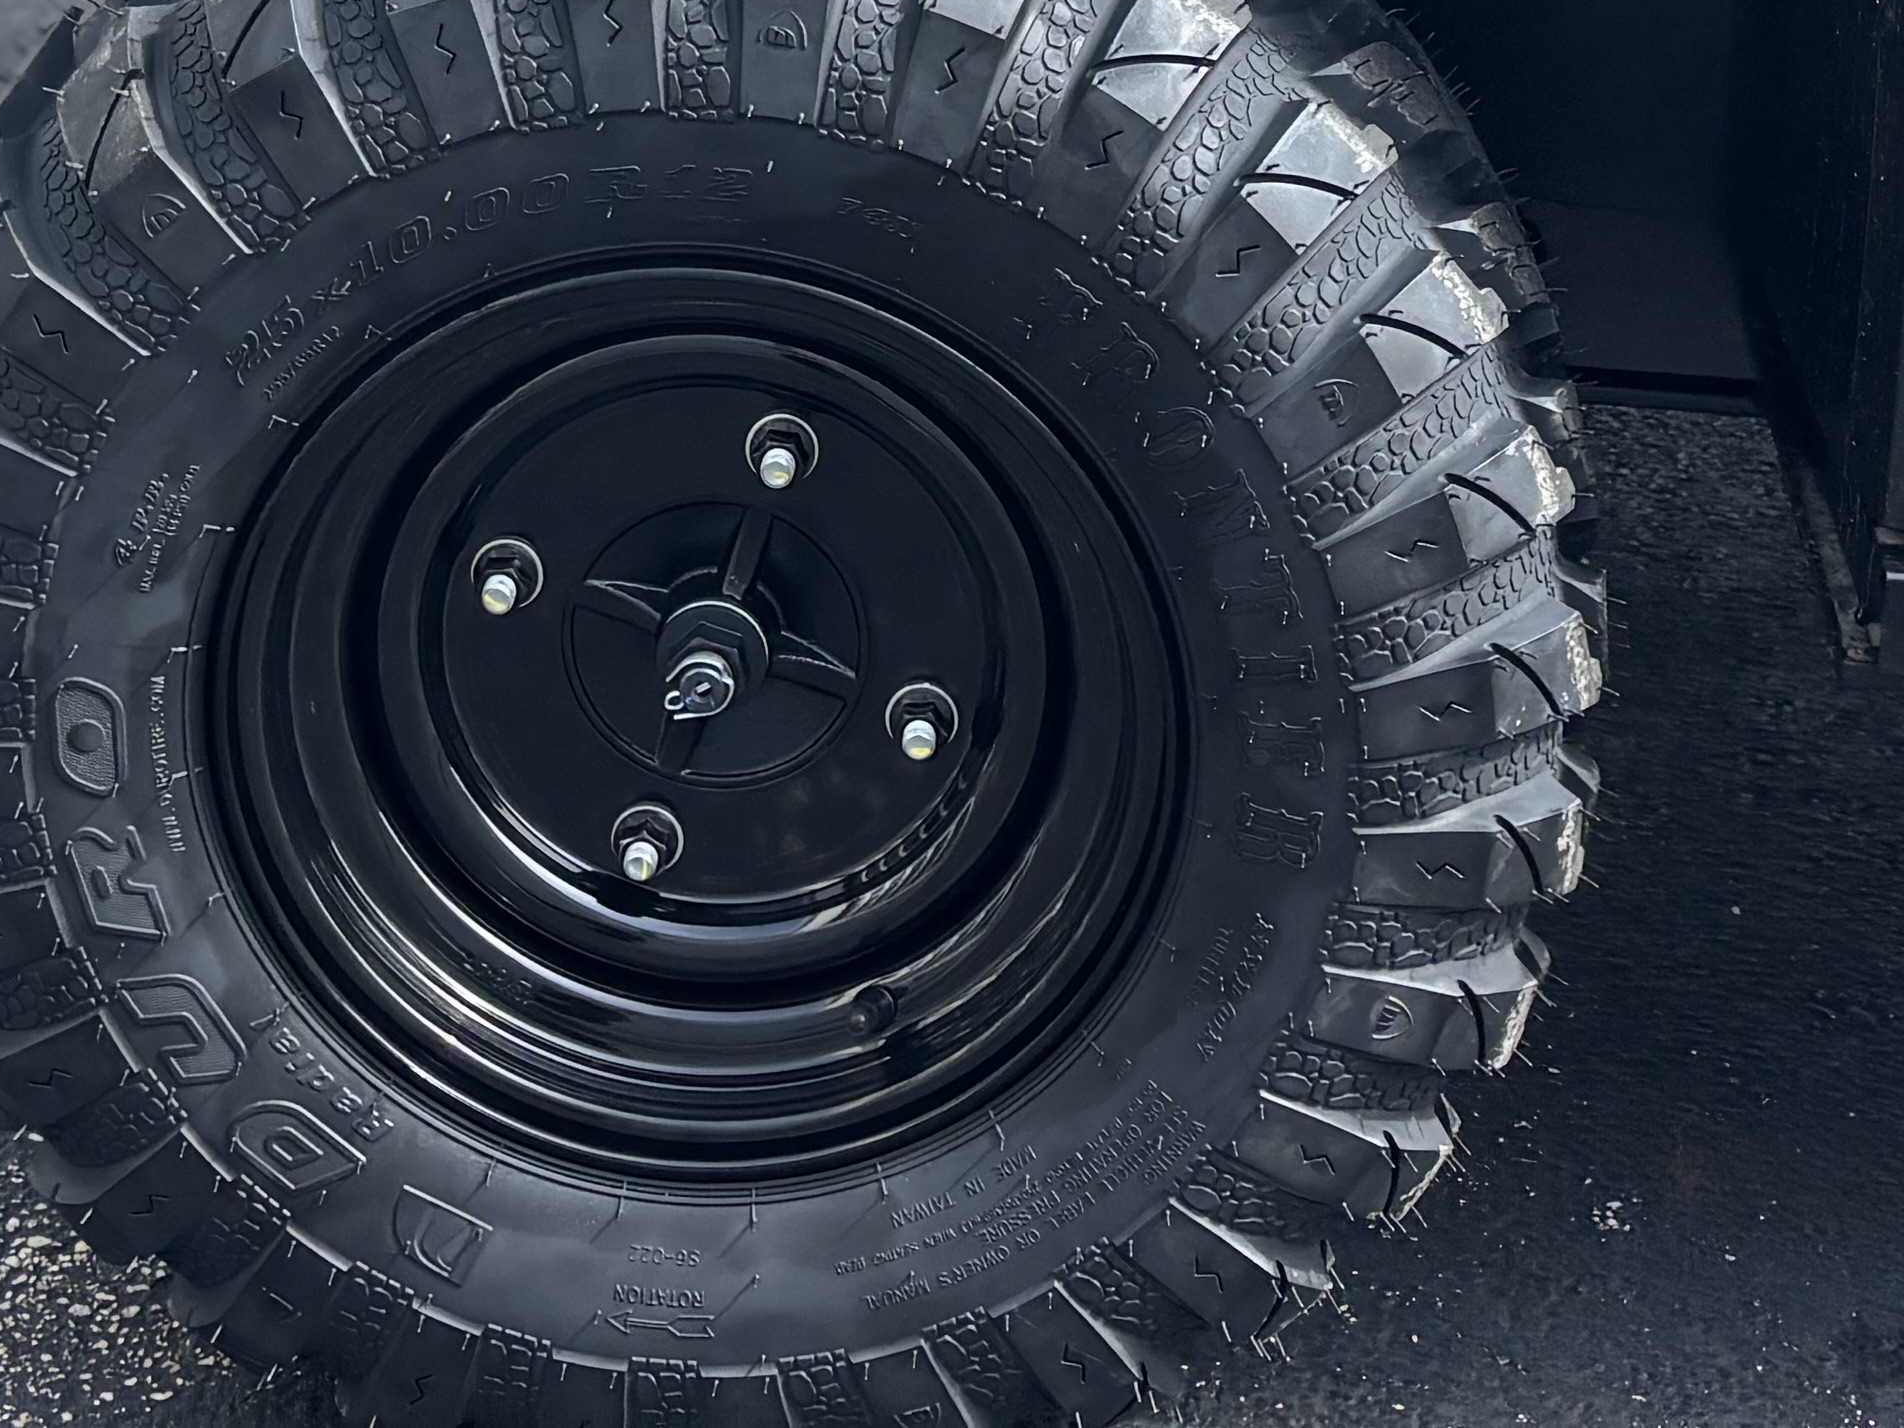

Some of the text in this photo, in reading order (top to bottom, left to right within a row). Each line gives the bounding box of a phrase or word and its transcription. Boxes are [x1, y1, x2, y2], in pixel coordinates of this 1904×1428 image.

[1012, 266, 1325, 870] FRONTIER
[54, 675, 368, 1191] DURO
[249, 1005, 395, 1142] Radial
[889, 1144, 1038, 1231] MADE IN TAIWAN
[611, 1281, 705, 1309] ROTATION
[863, 1278, 931, 1312] MANUAL
